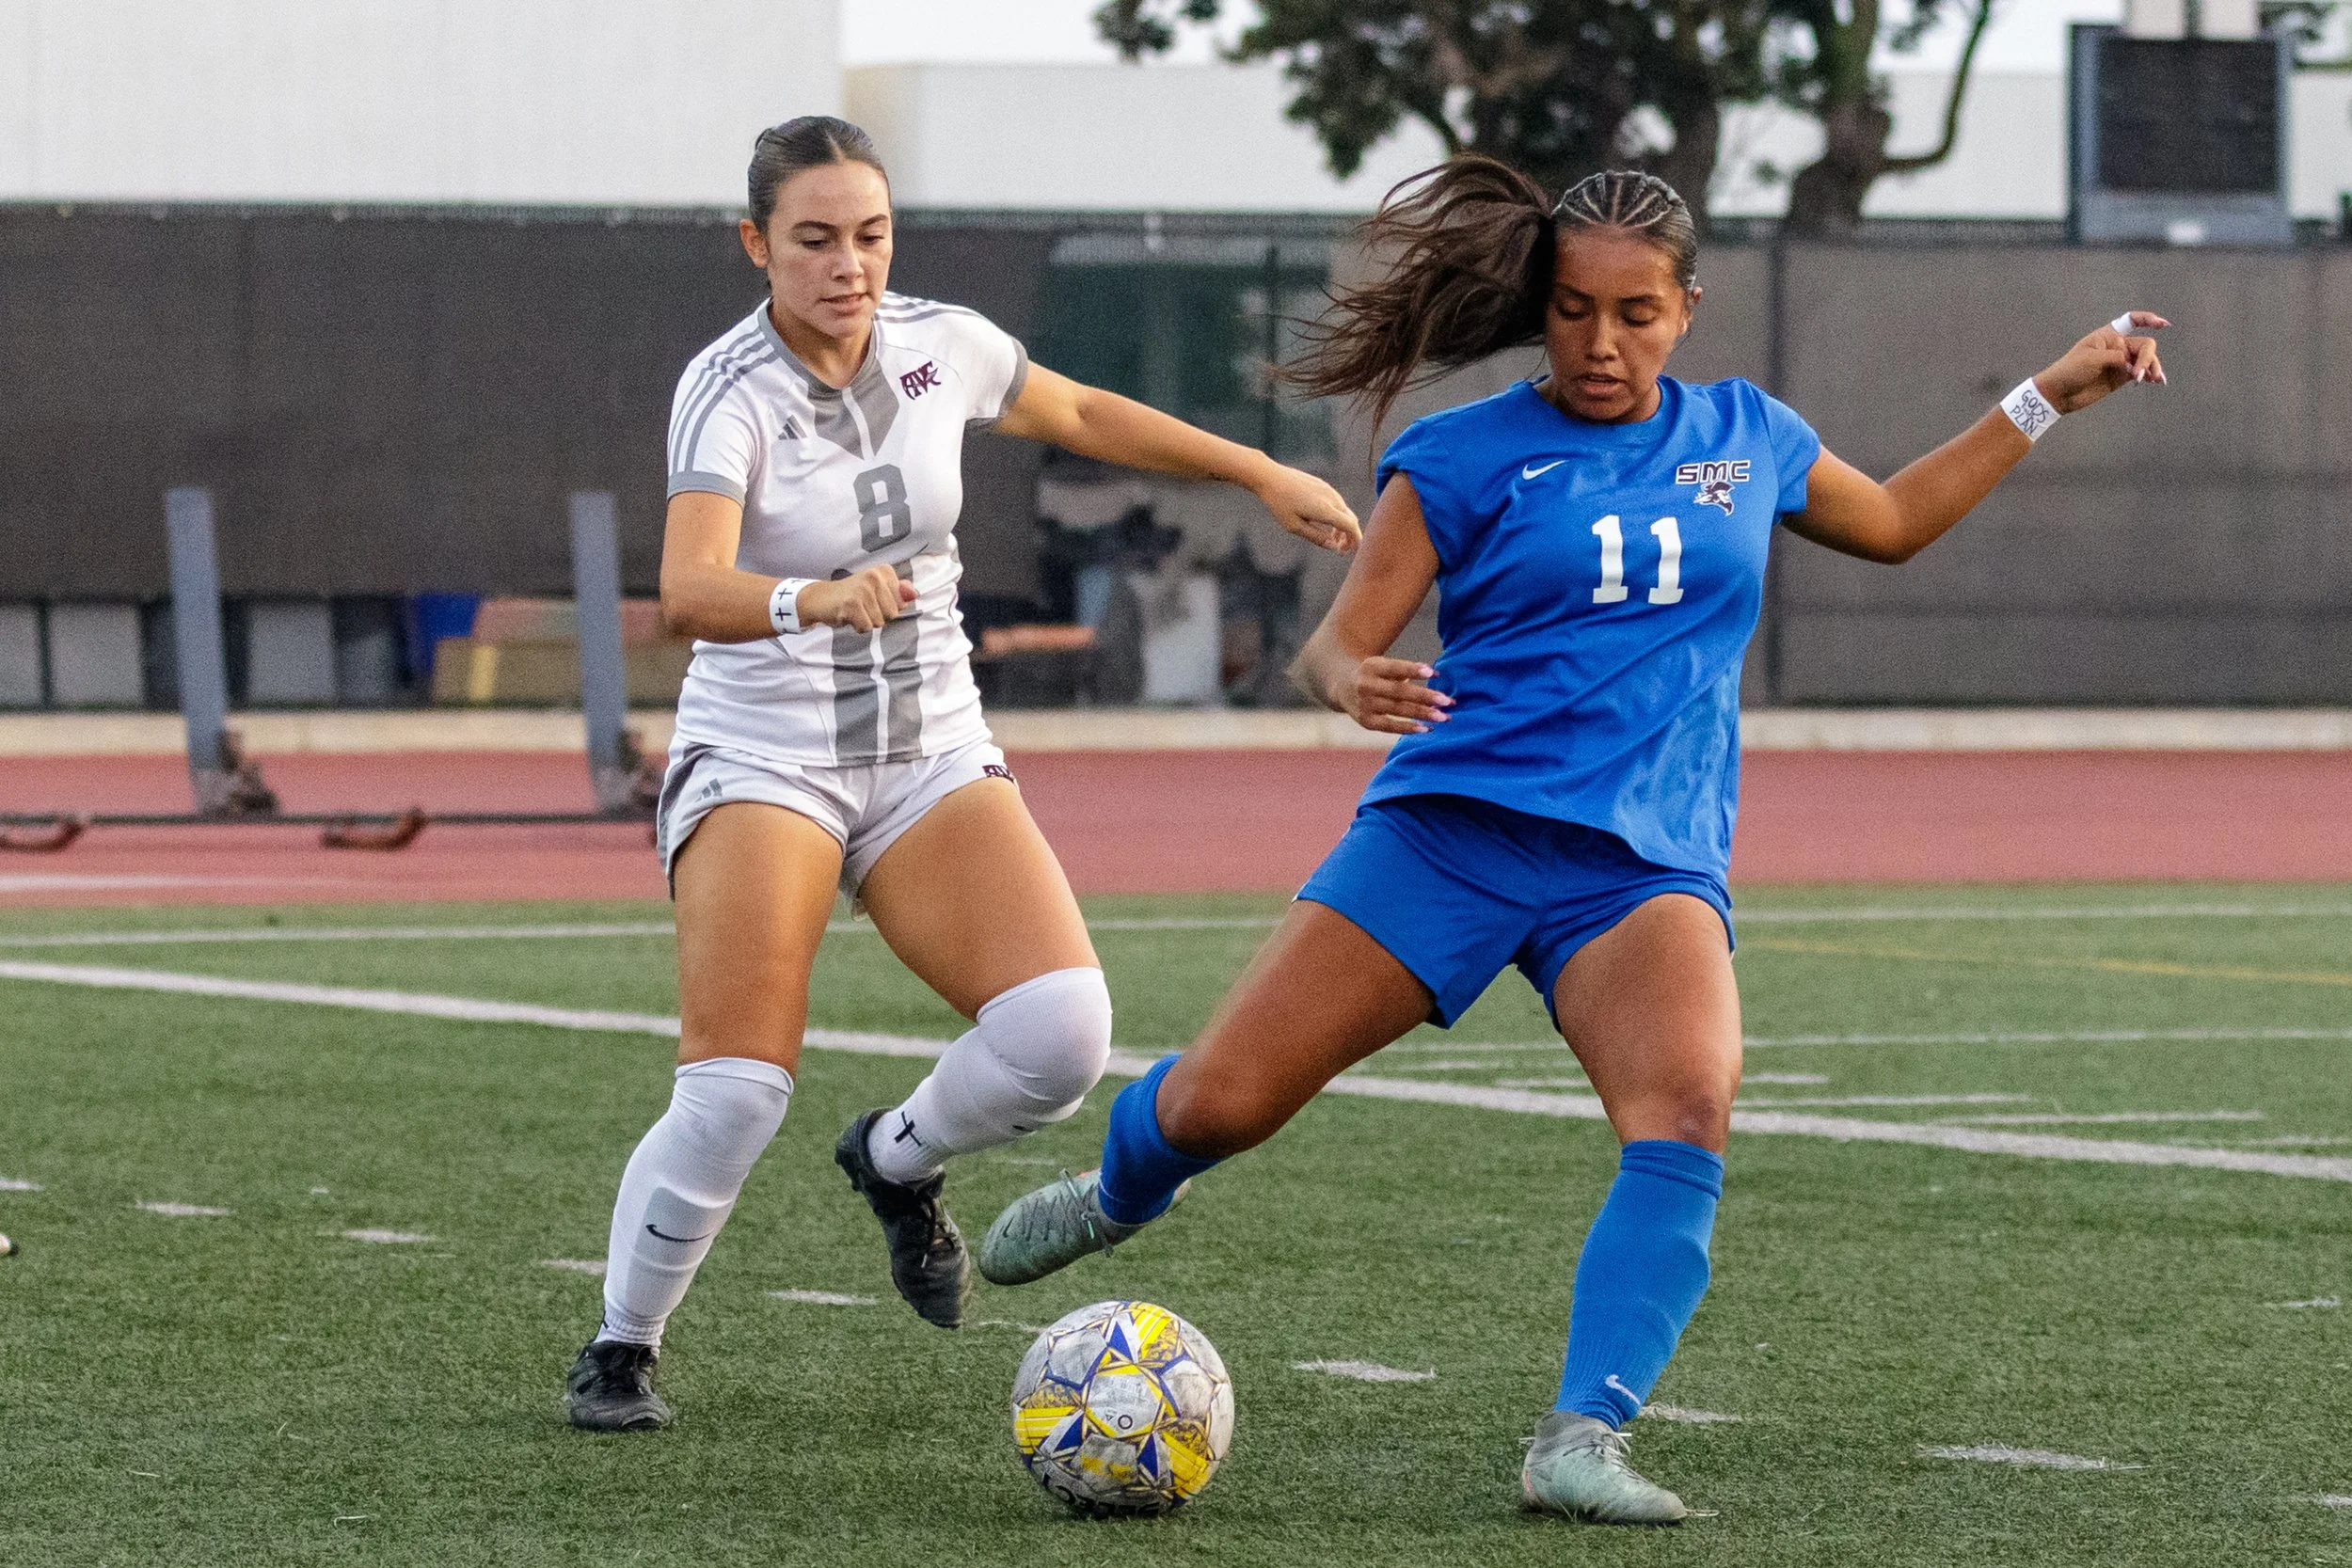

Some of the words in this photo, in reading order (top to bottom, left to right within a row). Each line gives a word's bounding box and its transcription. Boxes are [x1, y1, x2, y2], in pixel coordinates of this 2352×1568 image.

[2010, 404, 2039, 436] PLAN
[2021, 389, 2049, 423] GODS
[1675, 460, 1751, 484] SMC
[852, 464, 912, 553] 8
[1592, 515, 1684, 605] 11
